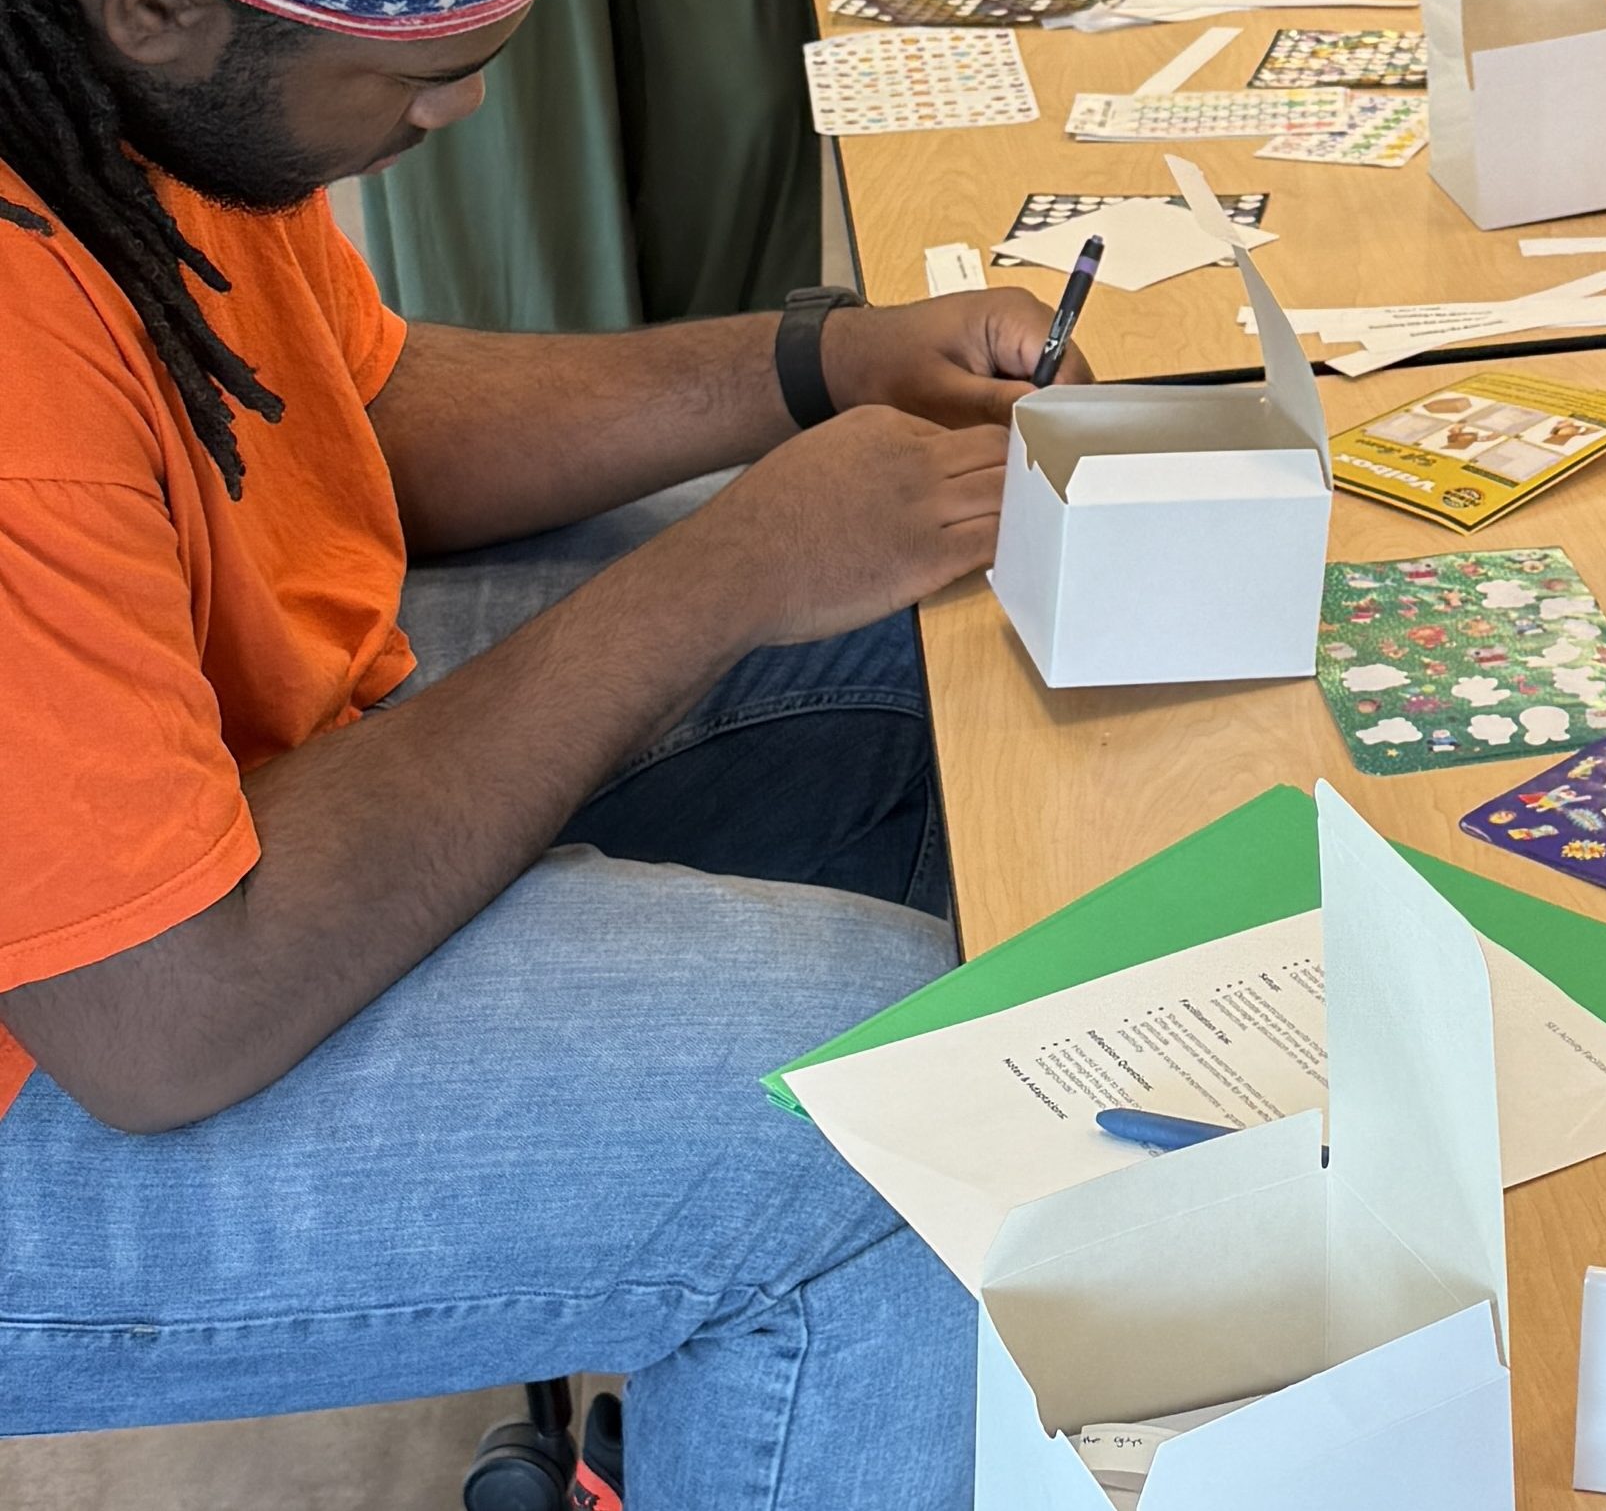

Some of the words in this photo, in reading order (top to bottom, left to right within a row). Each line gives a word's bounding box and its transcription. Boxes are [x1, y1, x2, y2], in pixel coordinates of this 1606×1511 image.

[1086, 1030, 1120, 1061] Reflection
[1558, 1032, 1583, 1053] Activity
[1003, 1058, 1024, 1077] Notes
